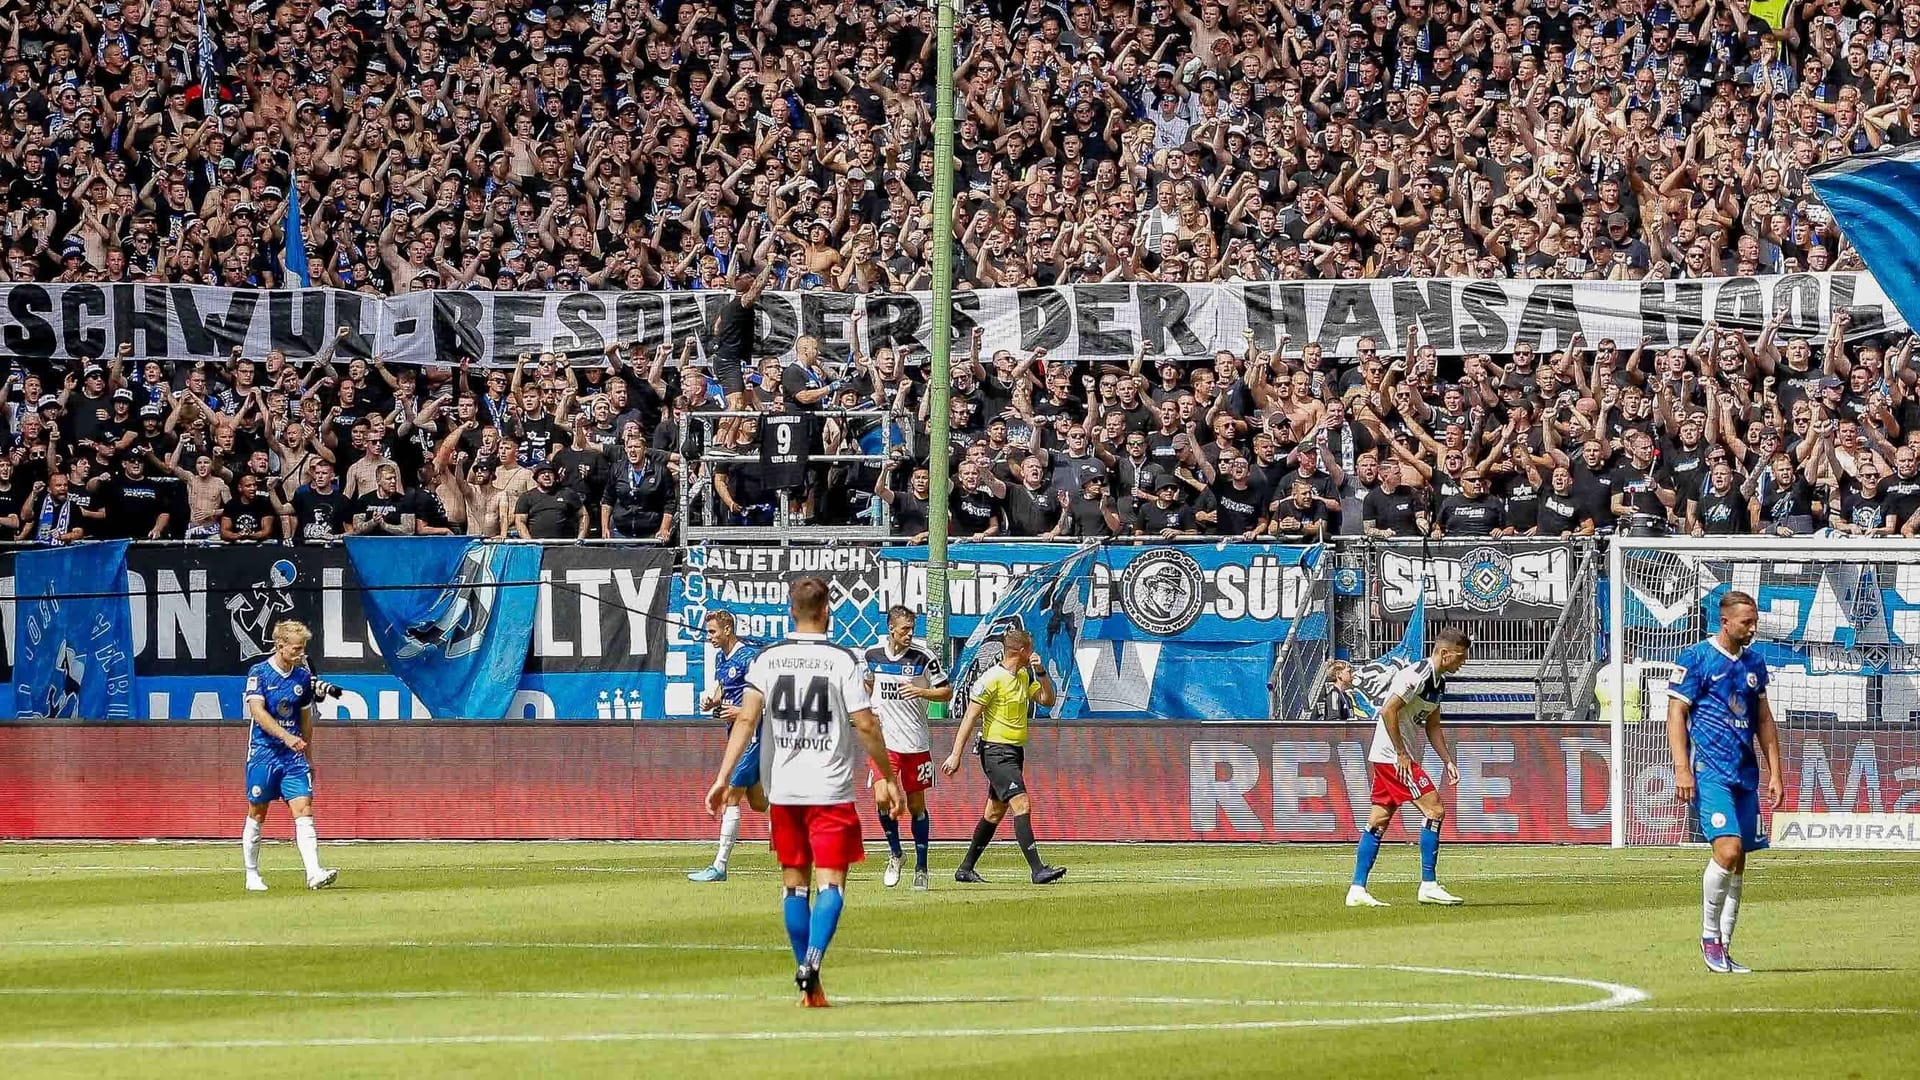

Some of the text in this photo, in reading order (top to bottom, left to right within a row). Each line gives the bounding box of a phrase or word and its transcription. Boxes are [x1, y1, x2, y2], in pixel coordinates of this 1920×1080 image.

[1019, 287, 1208, 356] DER
[1243, 280, 1586, 354] HANSA
[777, 424, 791, 454] 9
[789, 548, 872, 573] DURCH,
[771, 675, 833, 734] 44
[917, 761, 933, 781] 23
[1189, 740, 1521, 833] REWE
